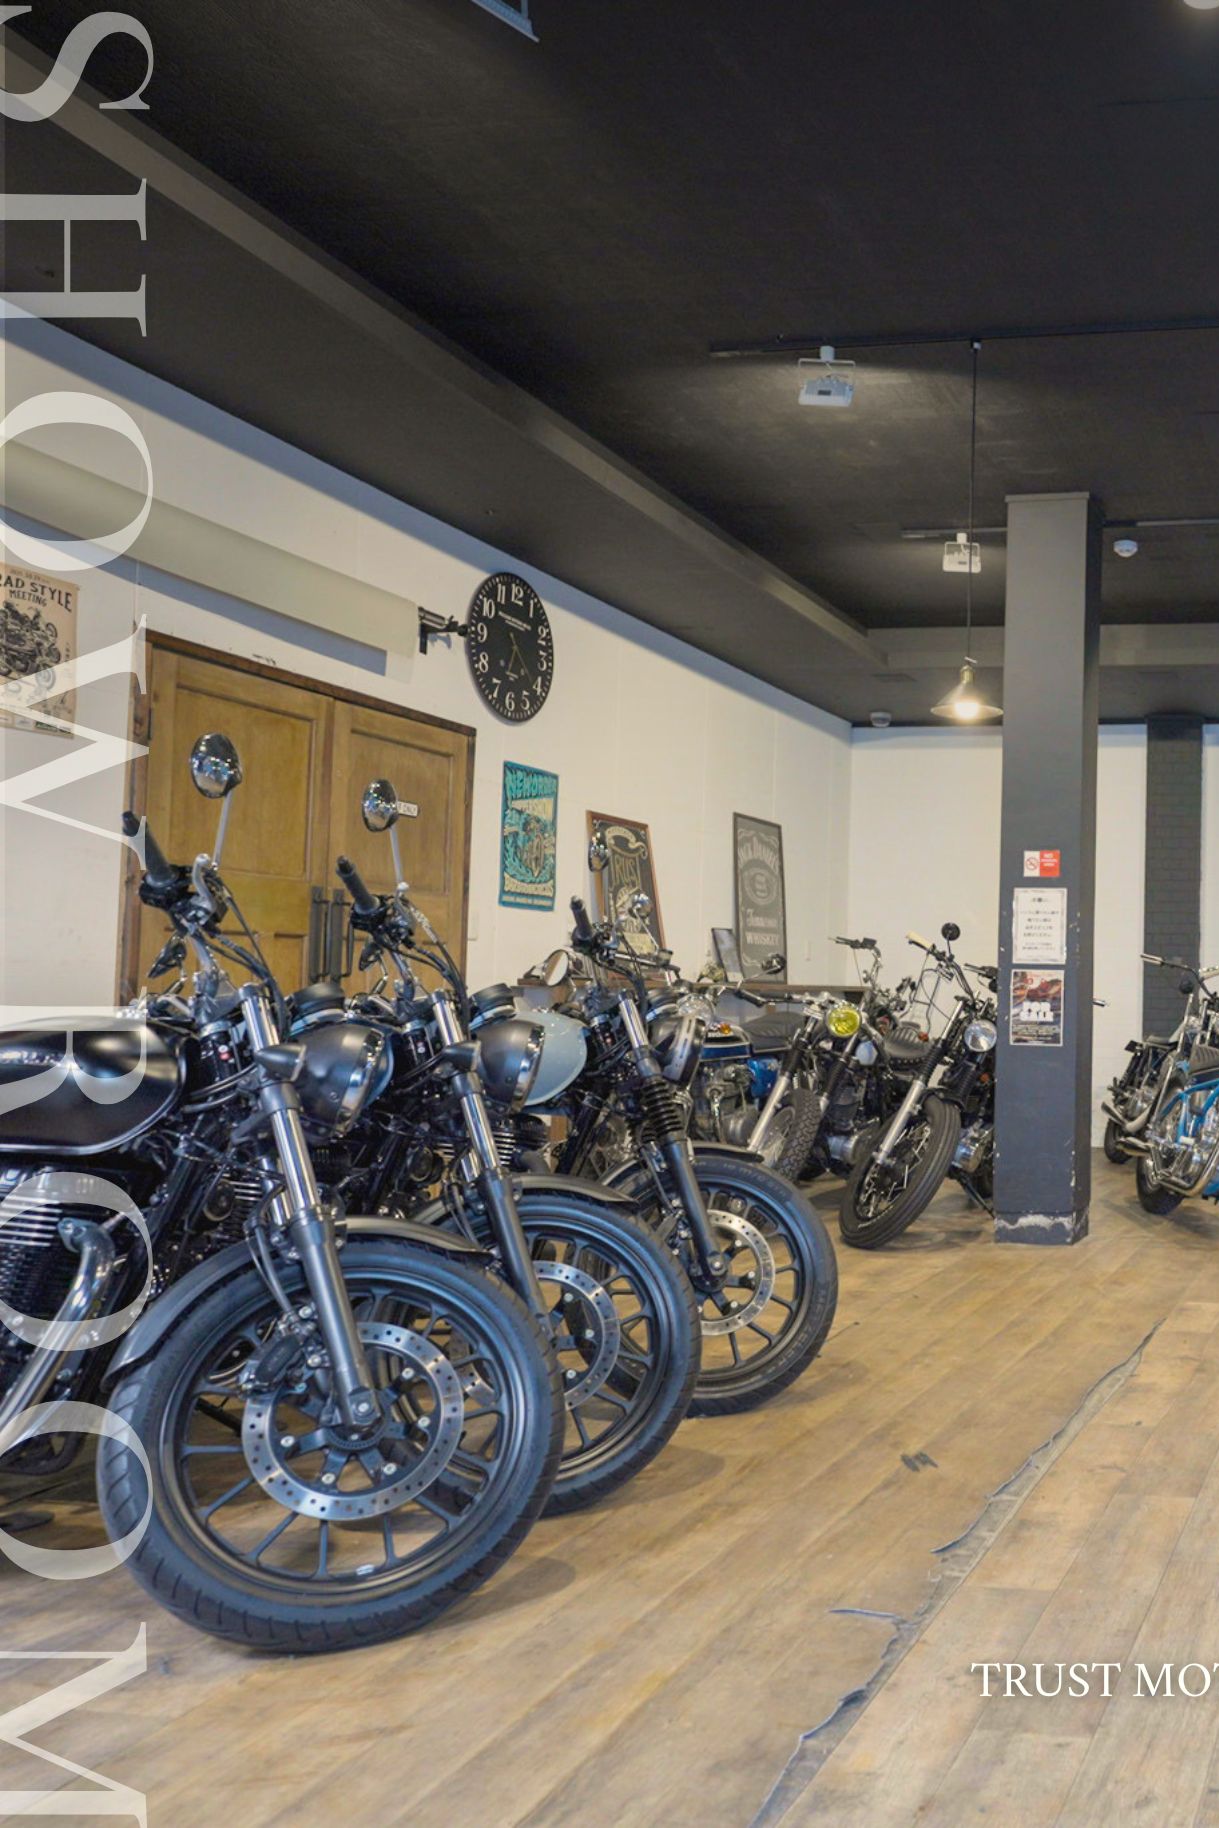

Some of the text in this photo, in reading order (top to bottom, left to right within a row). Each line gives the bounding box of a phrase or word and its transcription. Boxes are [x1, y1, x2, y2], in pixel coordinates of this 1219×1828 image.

[0, 573, 25, 589] AD
[30, 581, 72, 613] STYLE
[9, 589, 47, 607] MEETING
[497, 584, 505, 605] 11
[512, 583, 523, 606] 12
[483, 597, 495, 619] 10
[529, 600, 534, 618] 1
[477, 622, 487, 643] 9
[538, 625, 547, 646] 2
[479, 652, 488, 673] 8
[538, 650, 547, 671] 3
[492, 677, 501, 698] 7
[533, 676, 542, 696] 4
[505, 691, 515, 711] 6
[520, 690, 530, 710] 5
